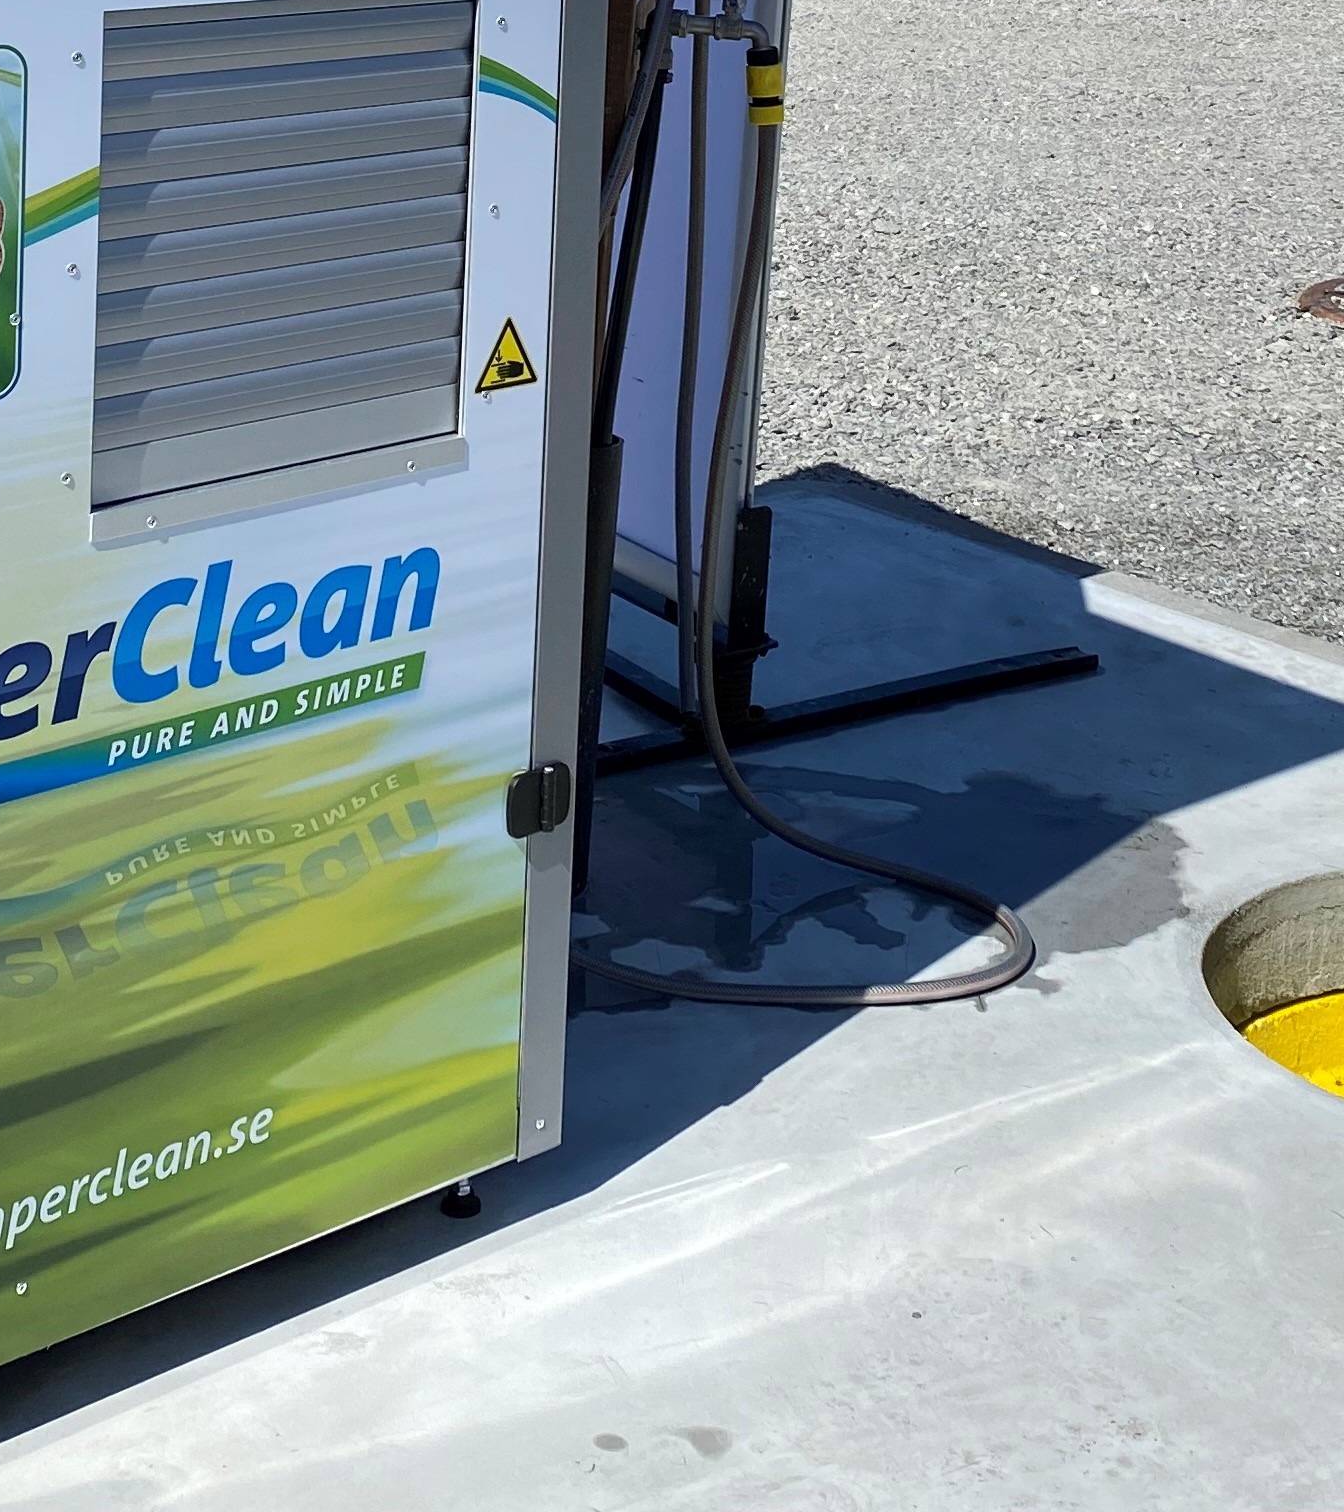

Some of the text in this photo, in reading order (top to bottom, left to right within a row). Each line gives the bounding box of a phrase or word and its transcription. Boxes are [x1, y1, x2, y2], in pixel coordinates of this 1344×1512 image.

[107, 663, 406, 767] PURE AND SIMPLE
